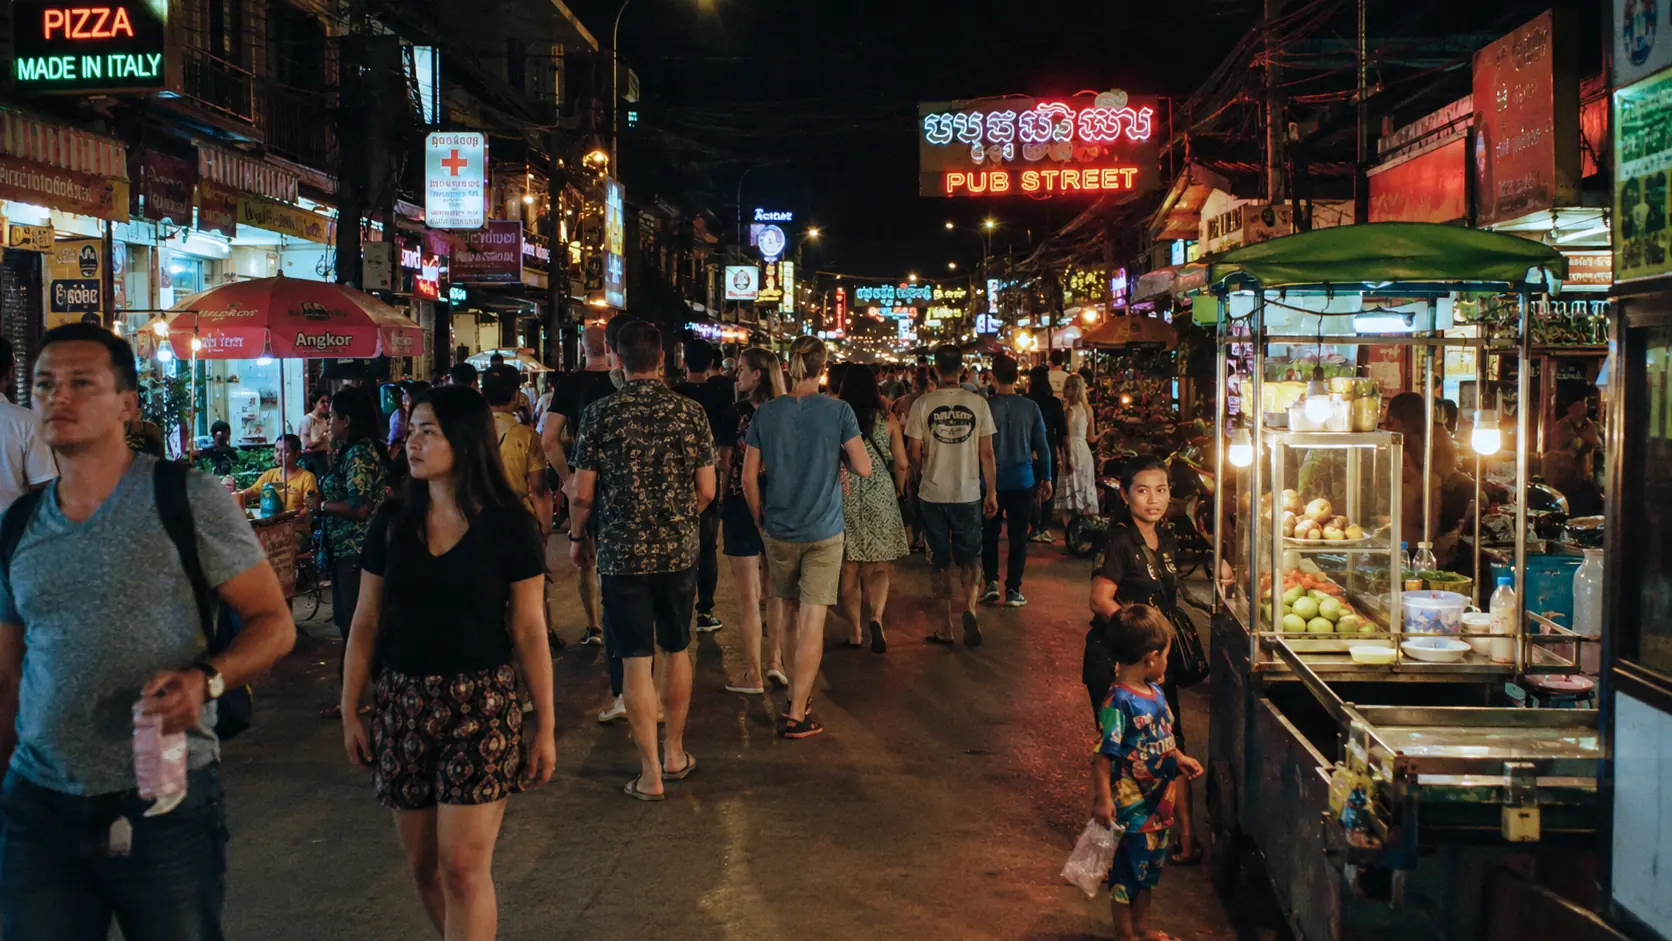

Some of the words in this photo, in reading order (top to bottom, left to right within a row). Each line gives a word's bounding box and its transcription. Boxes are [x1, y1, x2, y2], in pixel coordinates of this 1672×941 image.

[43, 6, 134, 40] PIZZA
[17, 55, 77, 81] MADE
[81, 54, 102, 79] IN
[107, 52, 162, 78] ITALY
[946, 171, 1010, 193] PUB
[1021, 167, 1138, 191] STREET
[295, 331, 353, 350] Angkor
